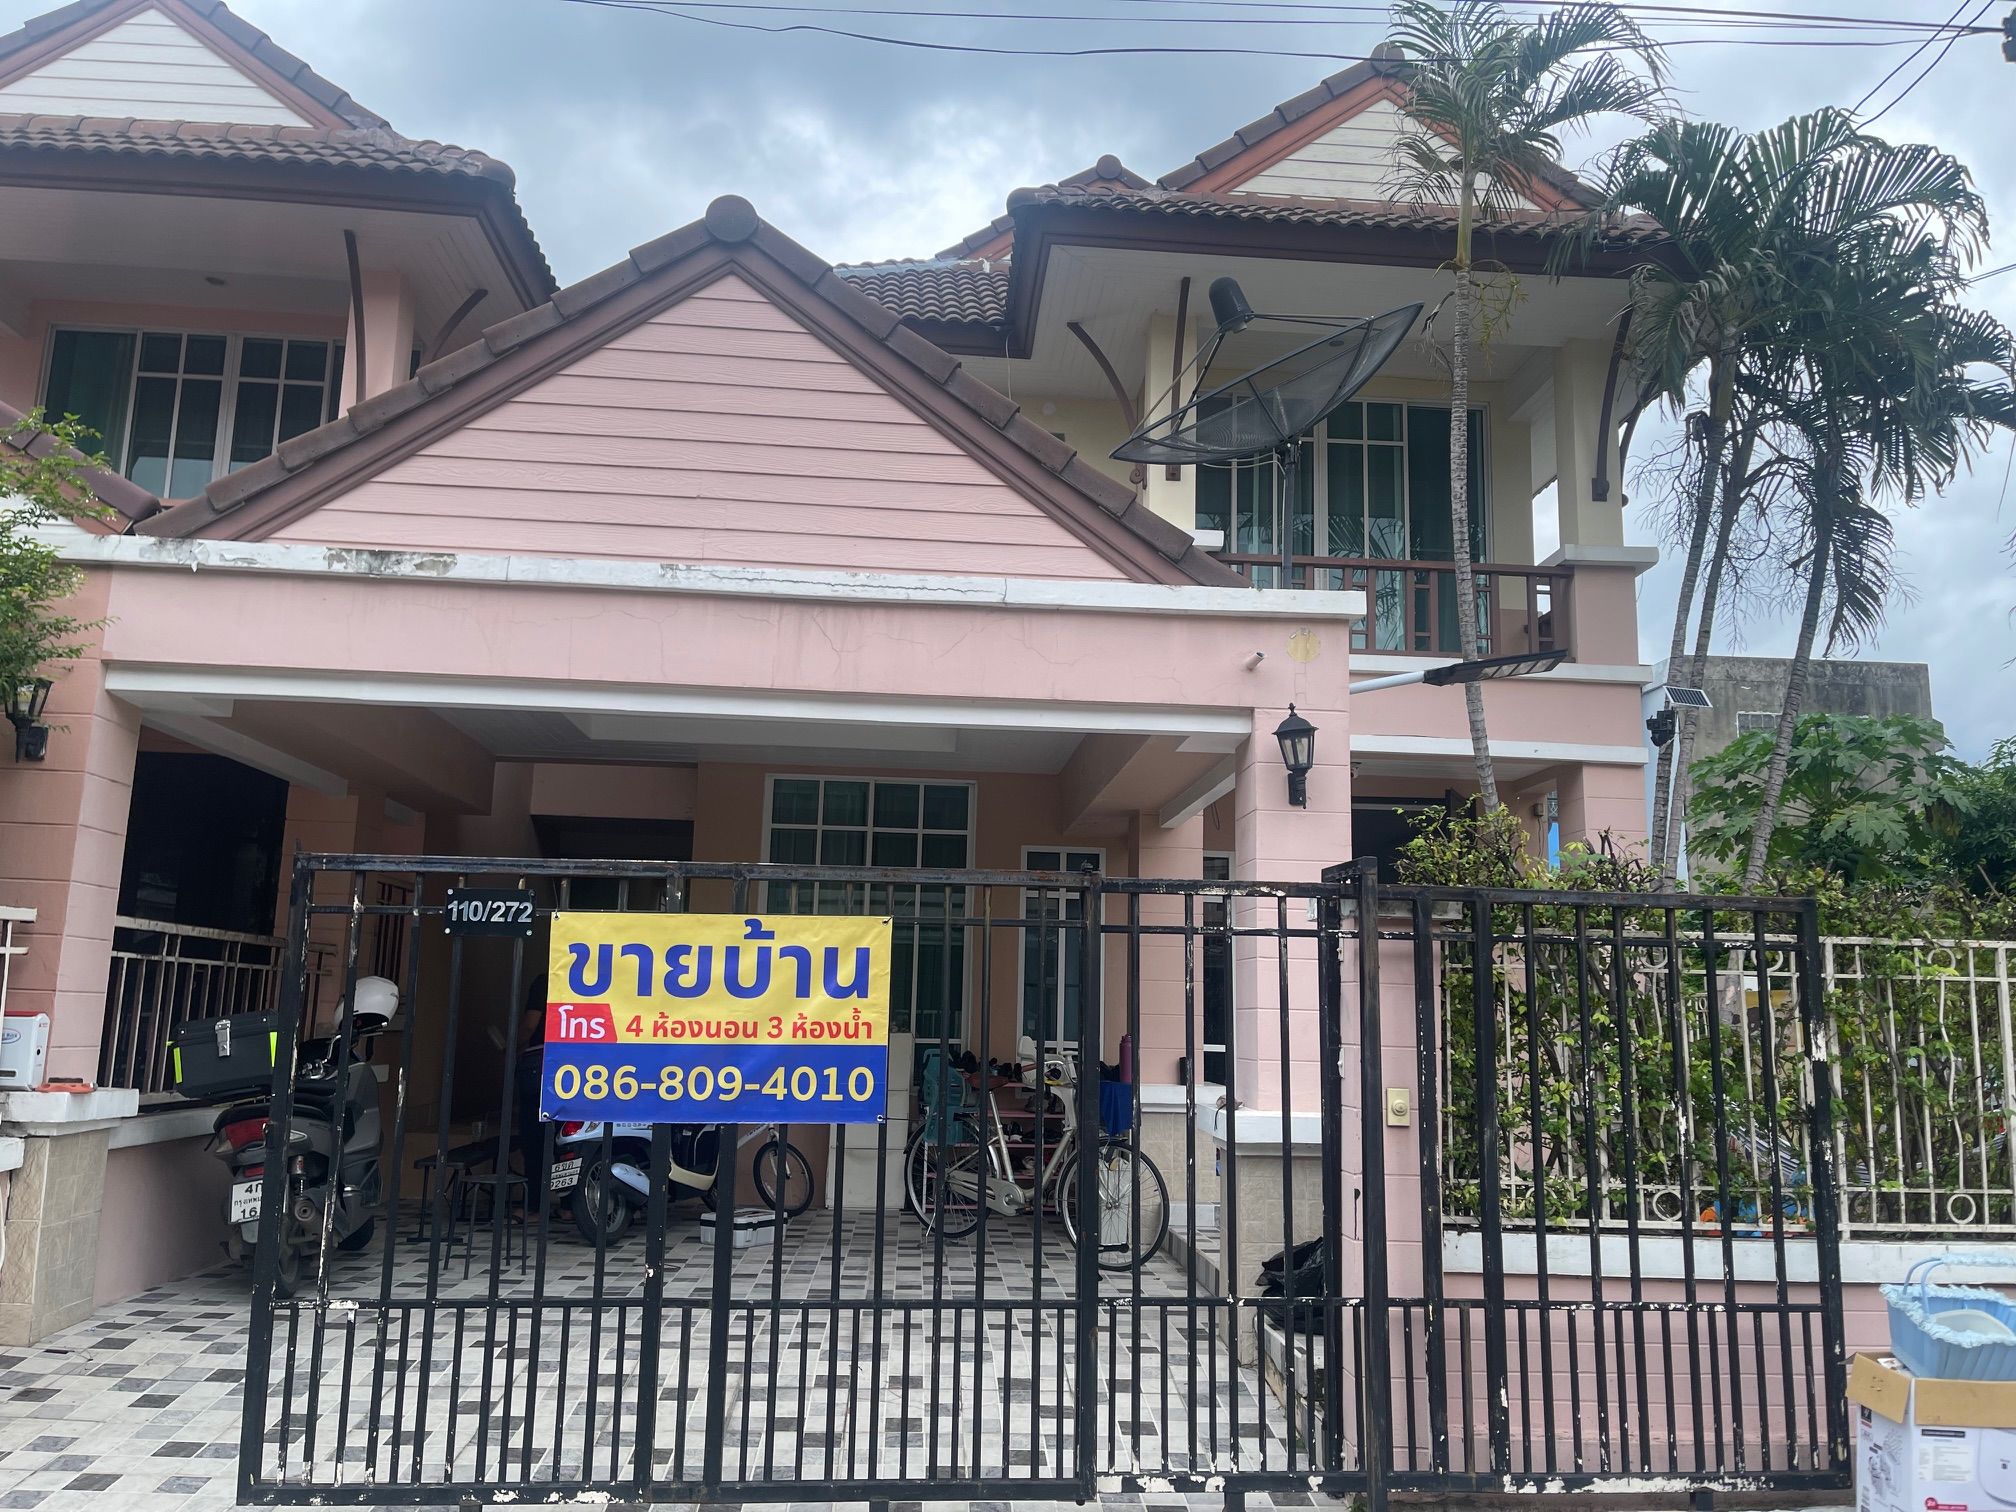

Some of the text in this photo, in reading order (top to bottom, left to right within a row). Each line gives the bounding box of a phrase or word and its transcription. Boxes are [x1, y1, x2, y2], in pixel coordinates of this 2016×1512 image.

[447, 900, 533, 922] 110/272
[568, 918, 870, 999] ขายบ้าน
[558, 1005, 606, 1039] โทร
[625, 1007, 873, 1039] 4 ห้องนอน 3 ห้องน้ำ
[554, 1064, 875, 1101] 086-809-4010
